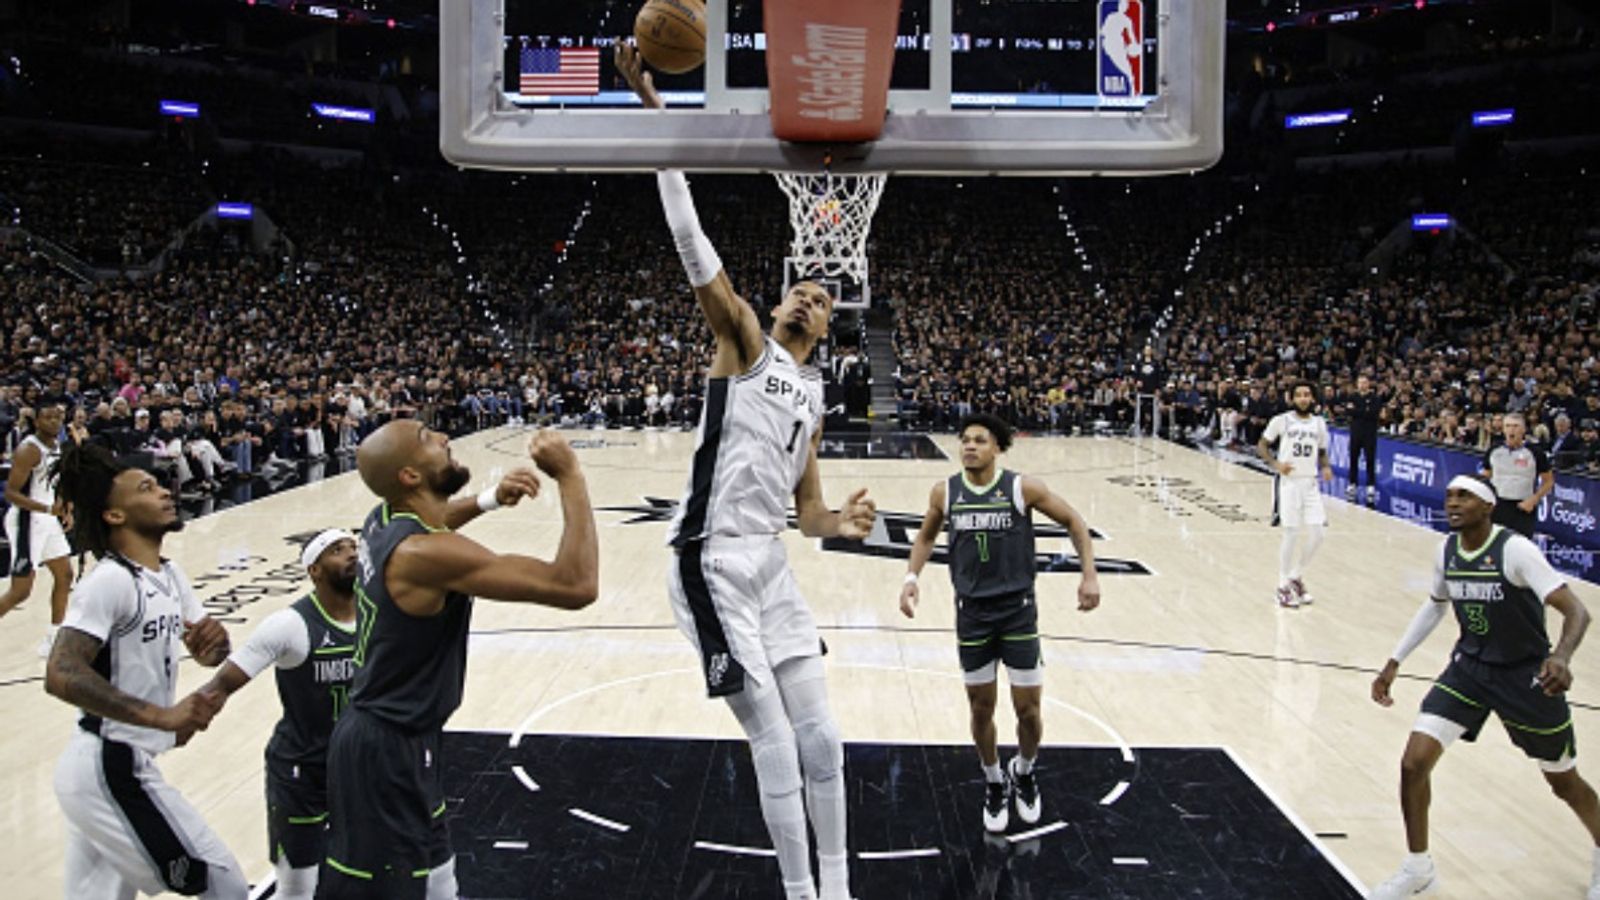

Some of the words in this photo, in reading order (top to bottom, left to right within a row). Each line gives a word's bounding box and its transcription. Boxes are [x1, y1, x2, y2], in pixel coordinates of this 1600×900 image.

[1104, 76, 1127, 93] NBA
[787, 420, 803, 454] 1
[1292, 443, 1313, 458] 30
[1551, 502, 1597, 533] Google
[975, 532, 990, 562] 1
[1463, 603, 1489, 635] 3
[313, 657, 354, 684] TIMBER
[331, 685, 350, 721] 1
